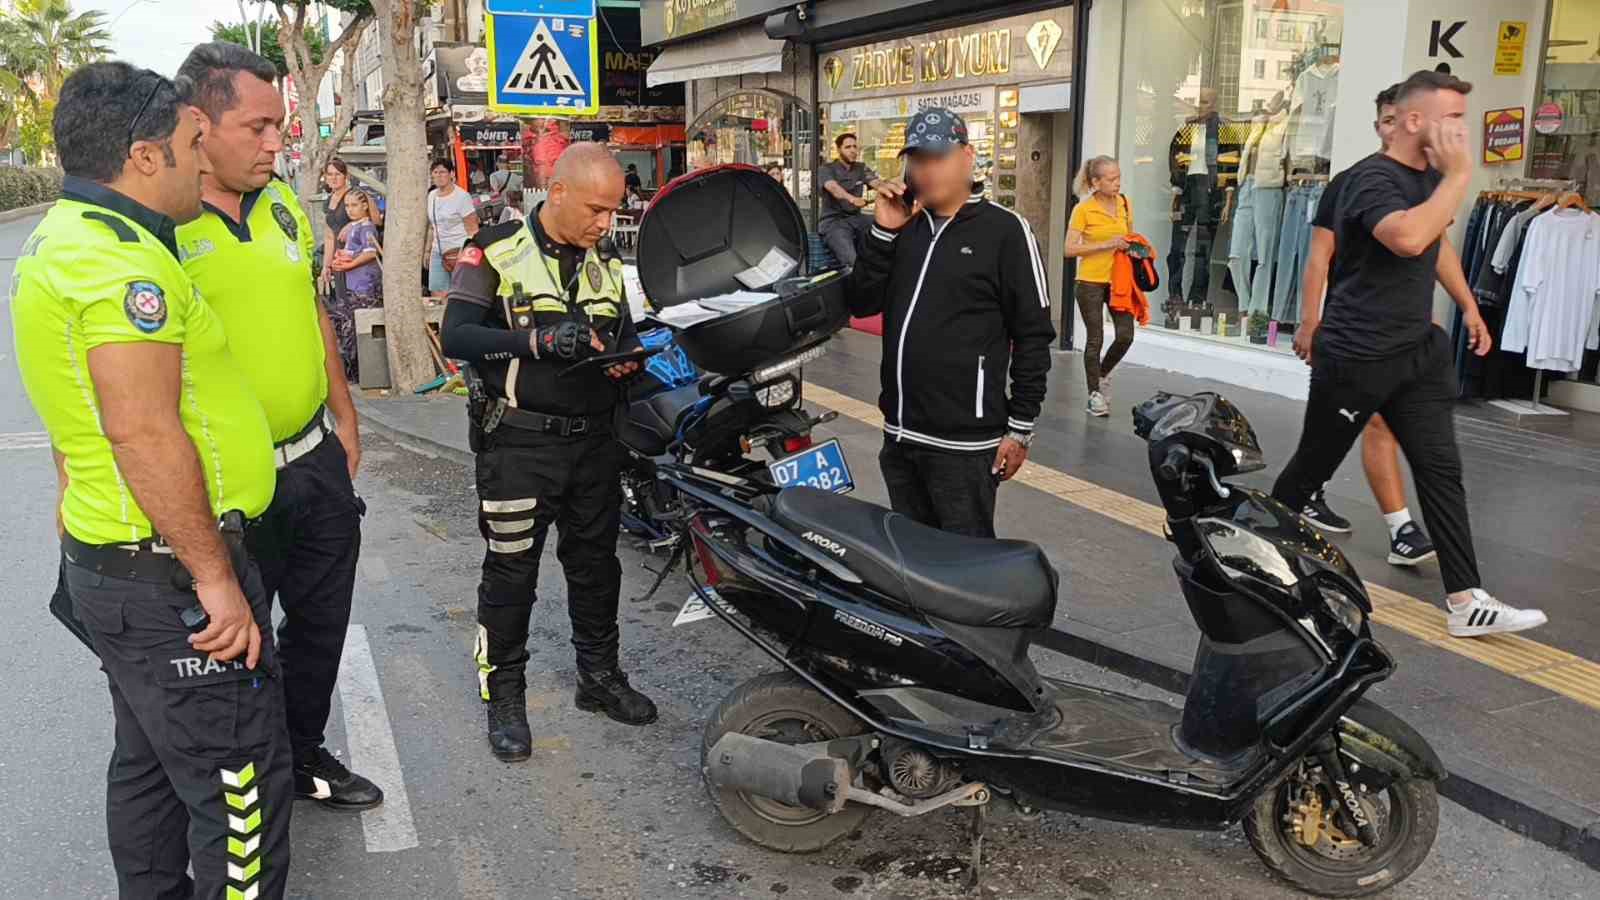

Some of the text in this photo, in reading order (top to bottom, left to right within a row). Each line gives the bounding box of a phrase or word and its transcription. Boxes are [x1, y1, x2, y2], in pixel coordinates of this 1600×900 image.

[1428, 20, 1468, 58] K
[920, 29, 1012, 82] KUYUM
[940, 92, 982, 107] MAĞAZASI
[569, 128, 593, 141] ÖNER
[775, 451, 828, 485] 07 A
[801, 531, 846, 557] ARORA
